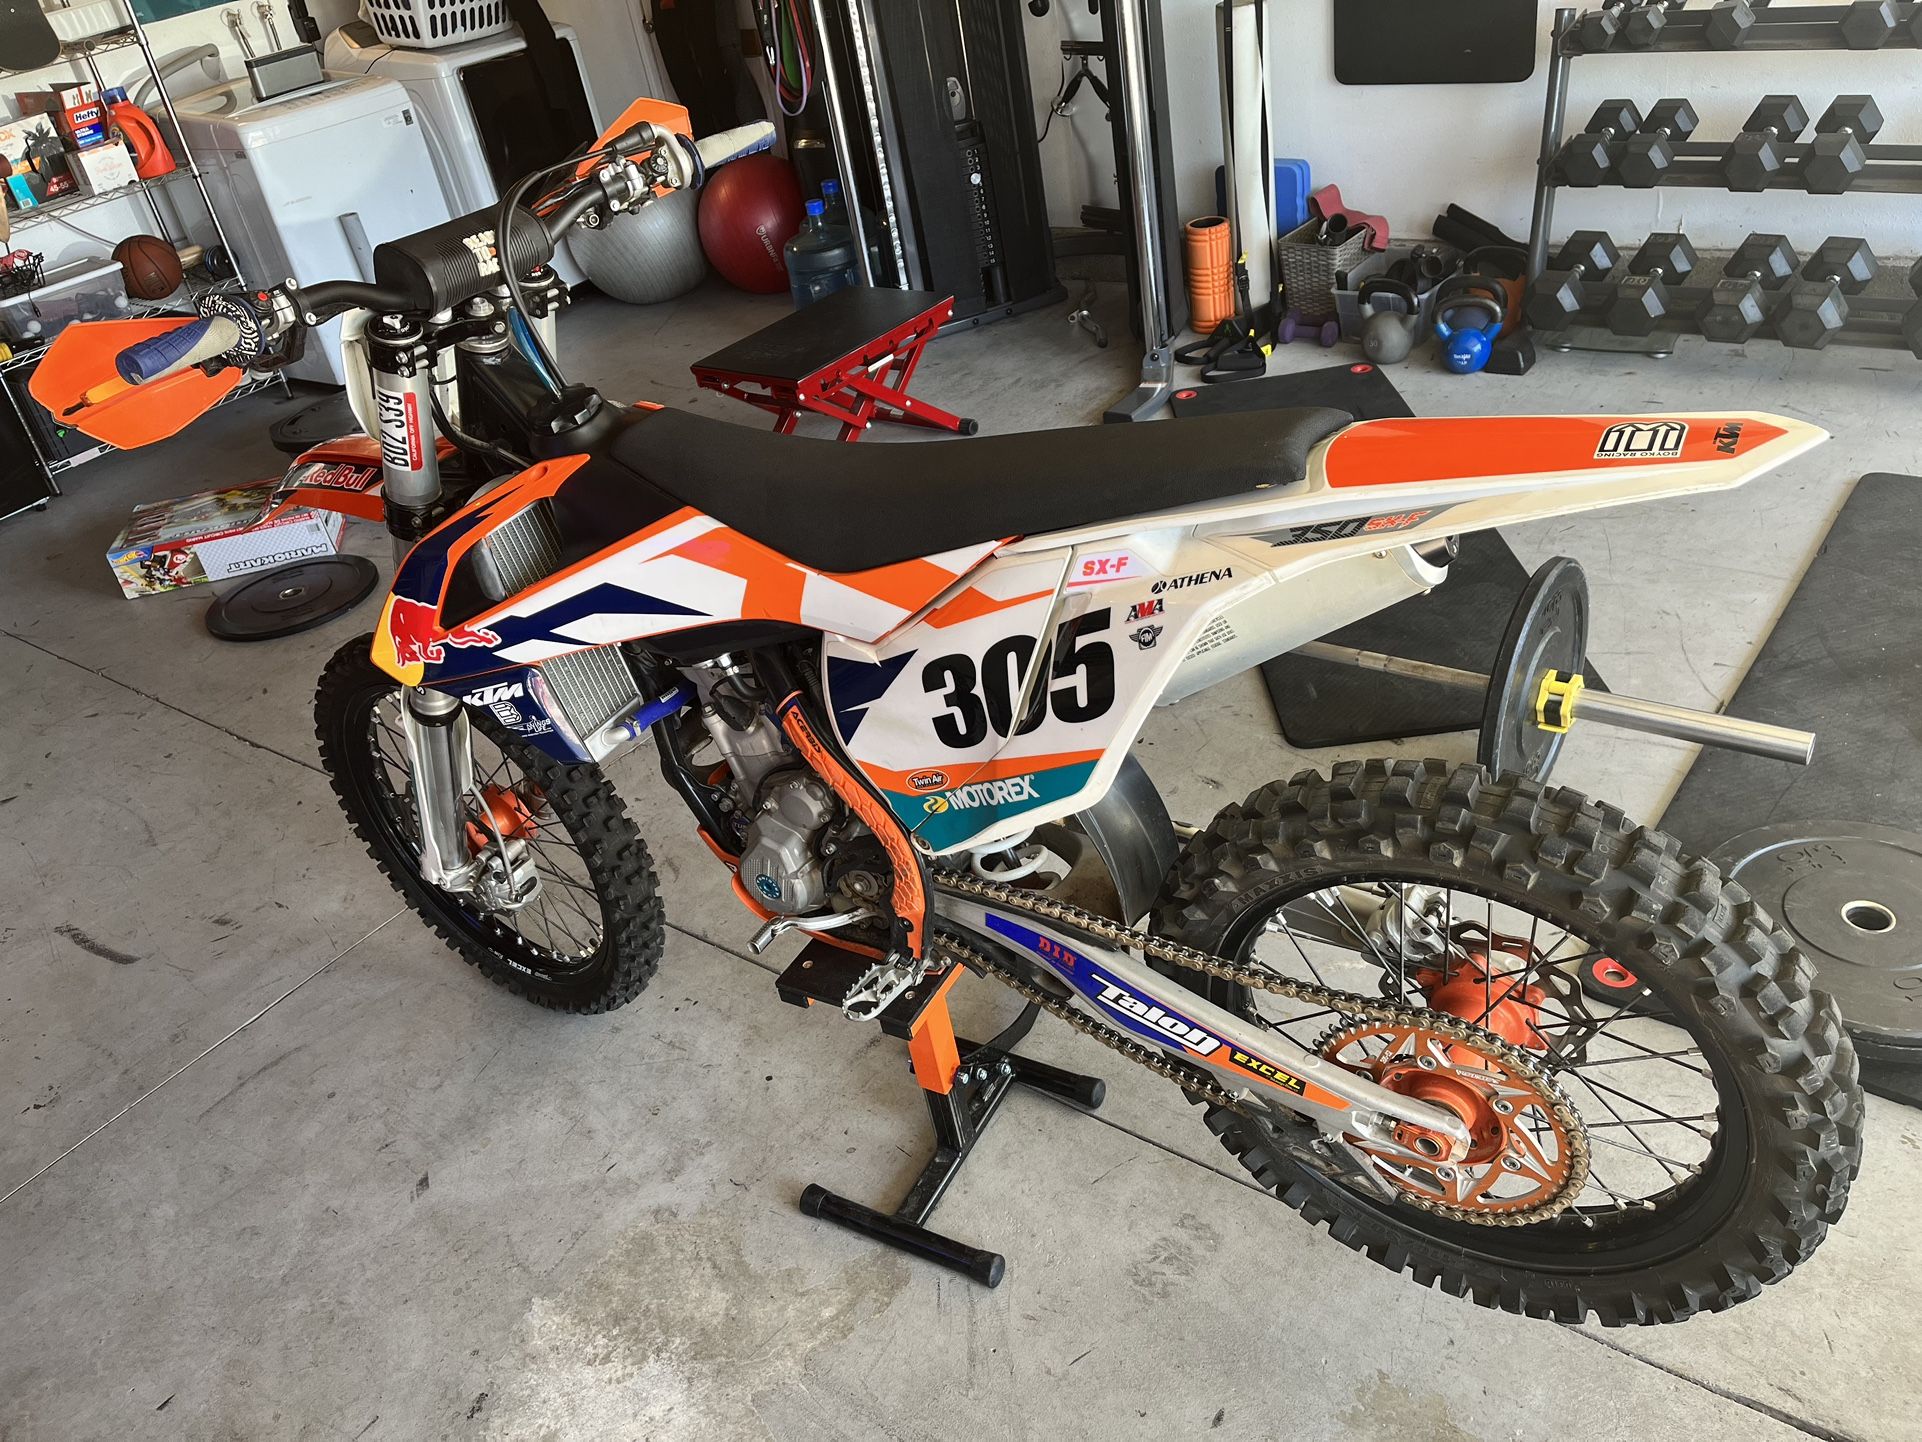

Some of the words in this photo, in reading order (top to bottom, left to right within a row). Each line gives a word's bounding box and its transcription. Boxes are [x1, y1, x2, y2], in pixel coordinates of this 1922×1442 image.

[75, 109, 99, 121] Hefty
[1713, 422, 1744, 455] KTM
[1082, 556, 1129, 576] SX-F
[1167, 567, 1233, 591] ATHENA
[1125, 598, 1166, 623] AMA
[921, 606, 1116, 749] 305
[463, 682, 524, 707] KTM
[912, 773, 931, 787] Twin
[931, 771, 944, 786] Air
[945, 775, 1041, 810] MOTOREX
[1236, 867, 1319, 906] MAXXIS
[507, 958, 532, 975] EXCEL
[1091, 973, 1222, 1056] Talon
[1232, 1051, 1301, 1090] EXCEL
